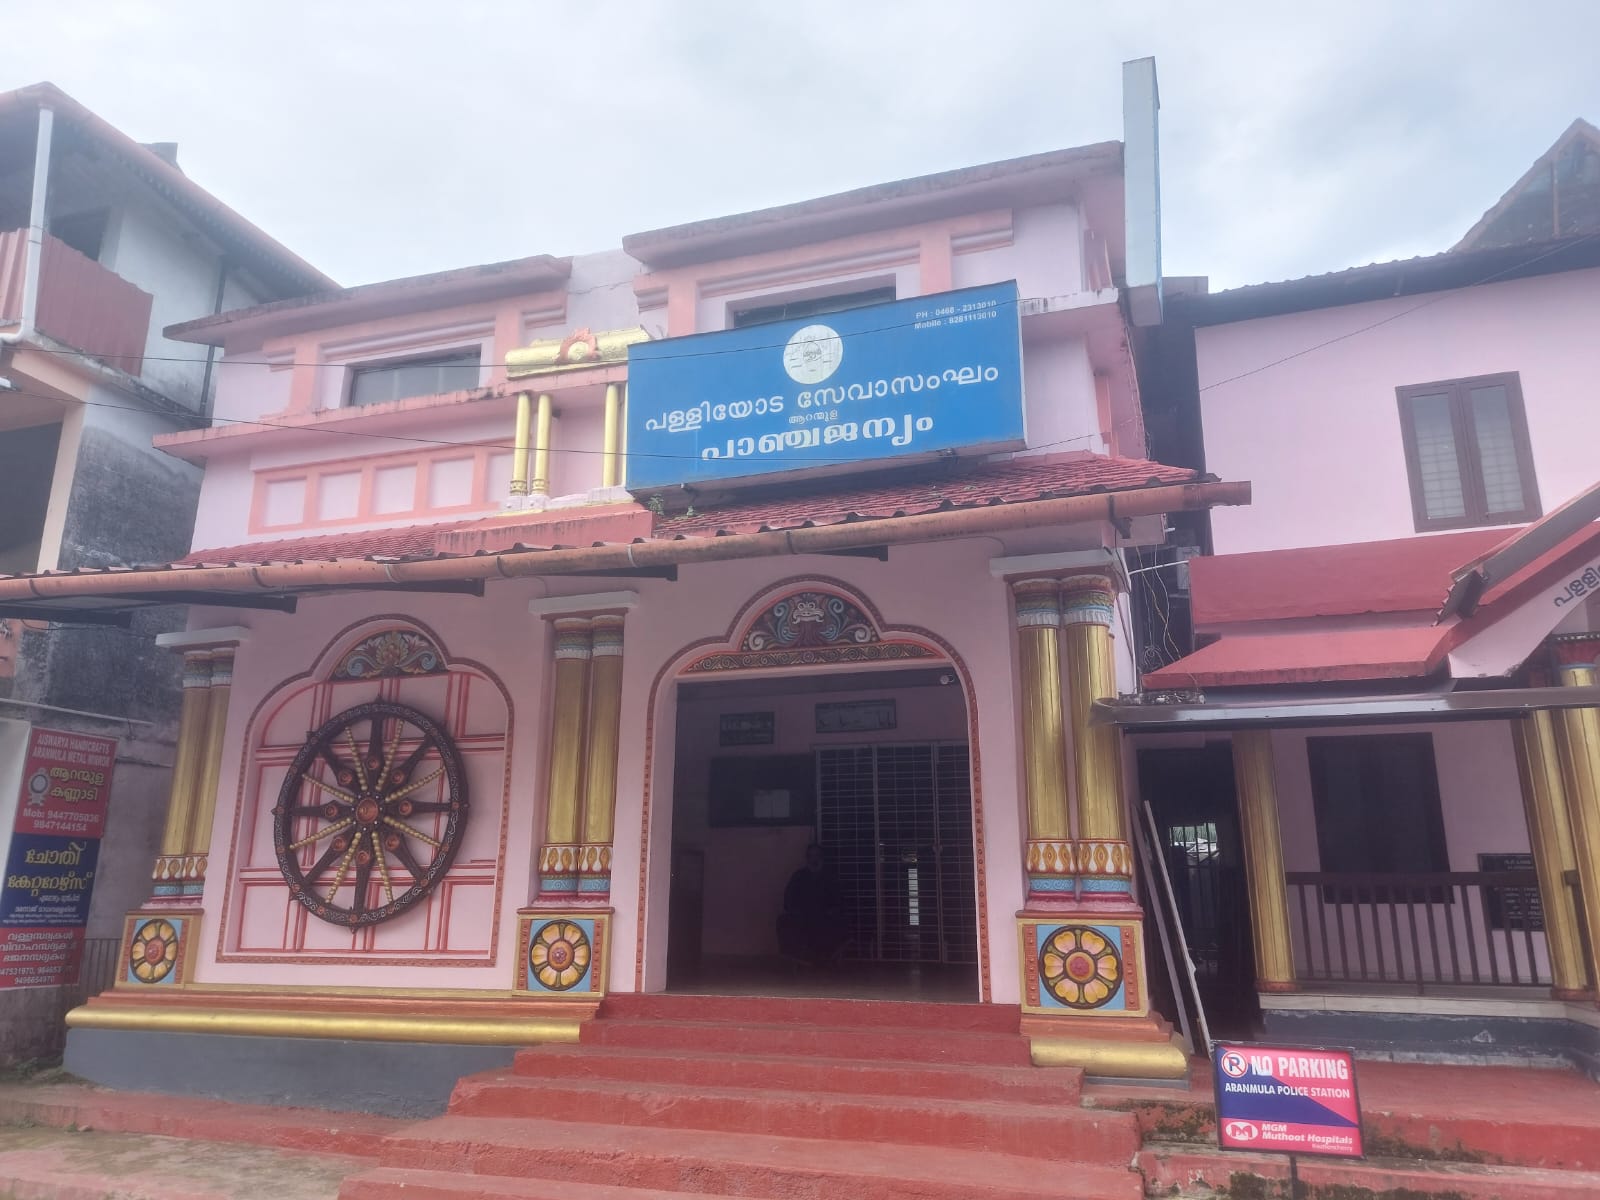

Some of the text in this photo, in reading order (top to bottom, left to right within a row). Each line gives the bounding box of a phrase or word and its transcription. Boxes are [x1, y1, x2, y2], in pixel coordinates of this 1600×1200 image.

[915, 311, 928, 319] PH
[914, 319, 942, 329] Mobile
[645, 363, 999, 433] പള്ളിയോട സേവാസംഘം
[701, 414, 934, 461] പാഞ്ചജന്യം
[1554, 564, 1600, 607] പള്ളി
[50, 767, 104, 786] ആറന്മുള
[51, 787, 98, 803] കണ്ണാടി
[23, 807, 45, 818] Mob:
[1250, 1055, 1349, 1080] NO PARKING
[1225, 1082, 1350, 1098] ARANMULA POLICE STATION
[1261, 1123, 1287, 1132] MGM
[1262, 1132, 1353, 1145] Muthoot Hospitals
